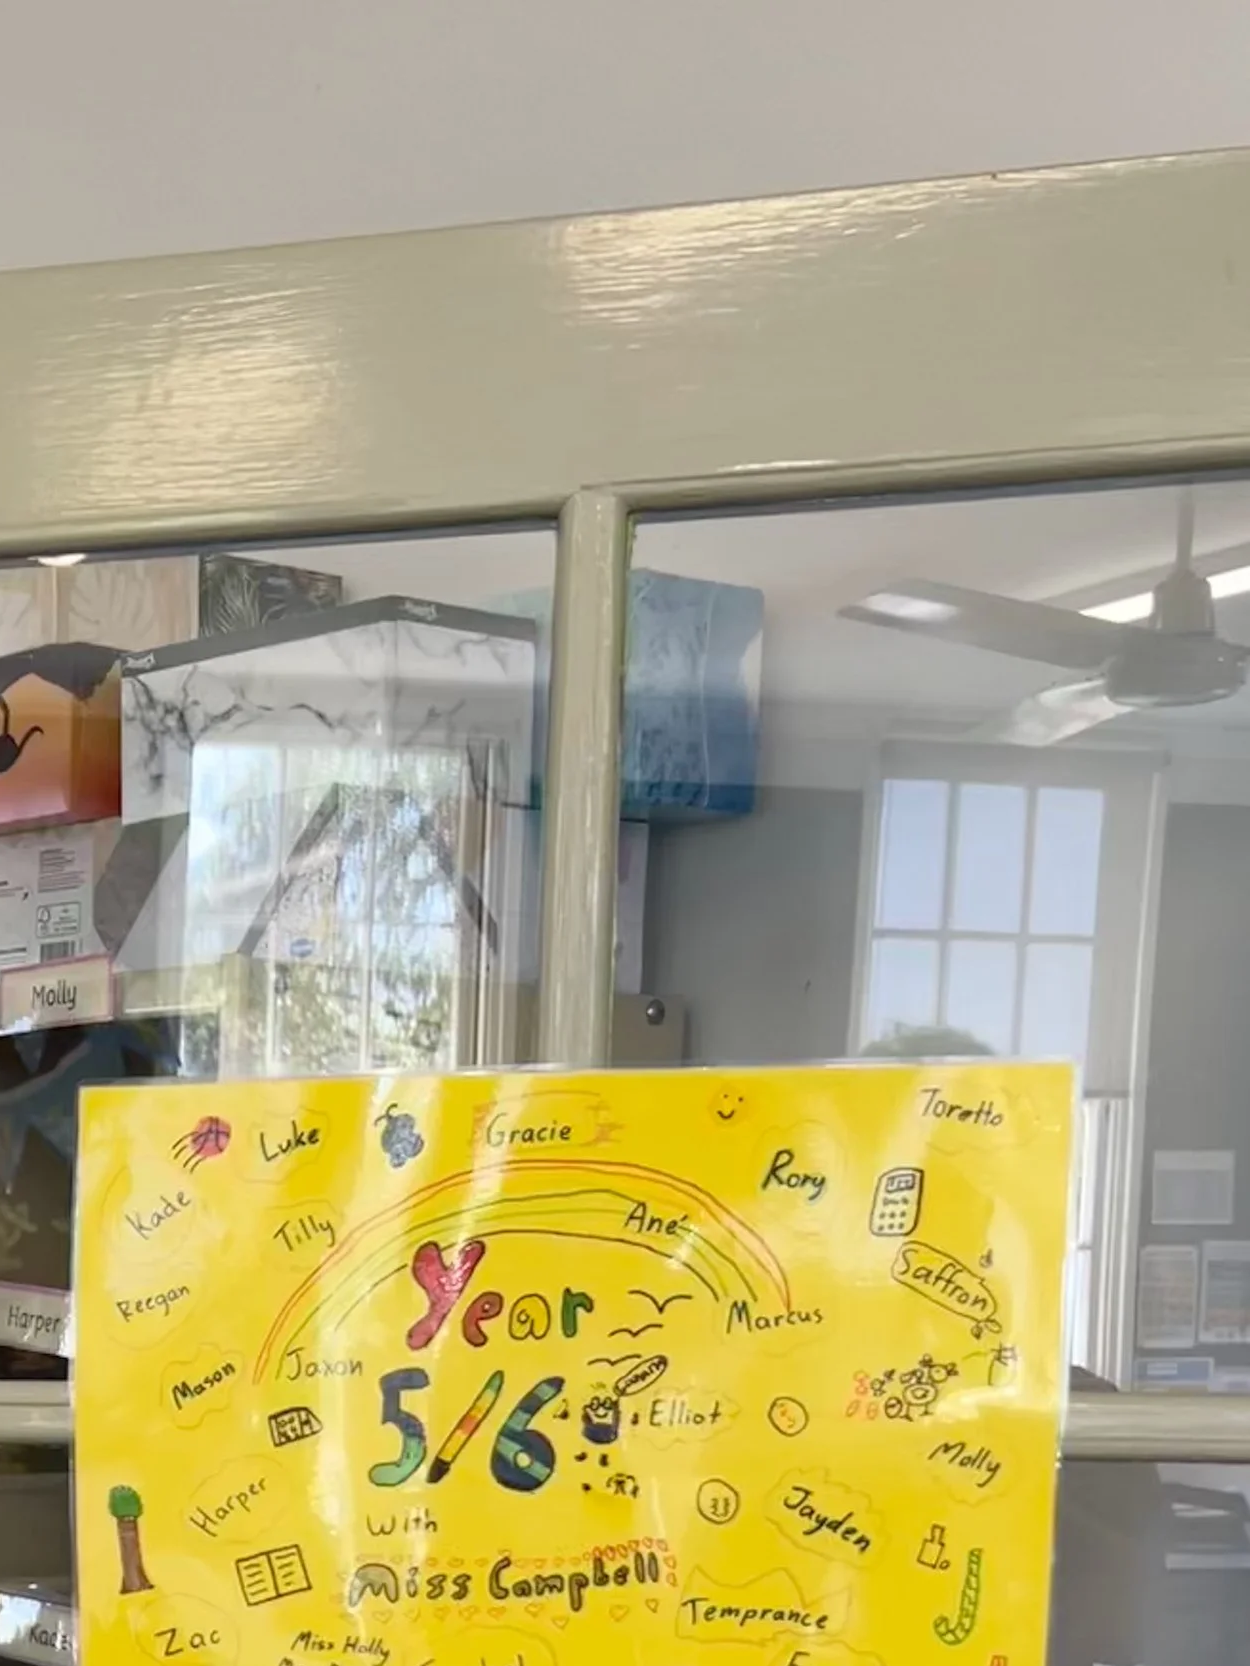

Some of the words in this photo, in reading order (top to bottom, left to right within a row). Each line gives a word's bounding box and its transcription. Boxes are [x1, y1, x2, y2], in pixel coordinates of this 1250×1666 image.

[31, 980, 78, 1011] Molly
[259, 1120, 321, 1163] Luke
[486, 1112, 573, 1146] Gracie
[762, 1149, 826, 1200] Rory
[125, 1190, 191, 1239] Kade
[273, 1215, 336, 1252] Tilly
[406, 1240, 595, 1351] Year
[899, 1248, 989, 1312] Saffron
[7, 1305, 61, 1338] Harper
[727, 1300, 824, 1335] Marcus
[172, 1361, 237, 1410] Mason
[369, 1367, 566, 1494] 5/6
[649, 1398, 722, 1429] Elliot
[927, 1442, 1002, 1488] Molly
[191, 1476, 268, 1537] Harper
[783, 1486, 873, 1555] Jayden
[349, 1562, 472, 1608] Miss
[488, 1550, 660, 1613] Campbell
[682, 1598, 829, 1632] Temprance
[154, 1627, 223, 1658] Zac
[291, 1630, 334, 1651] Miss
